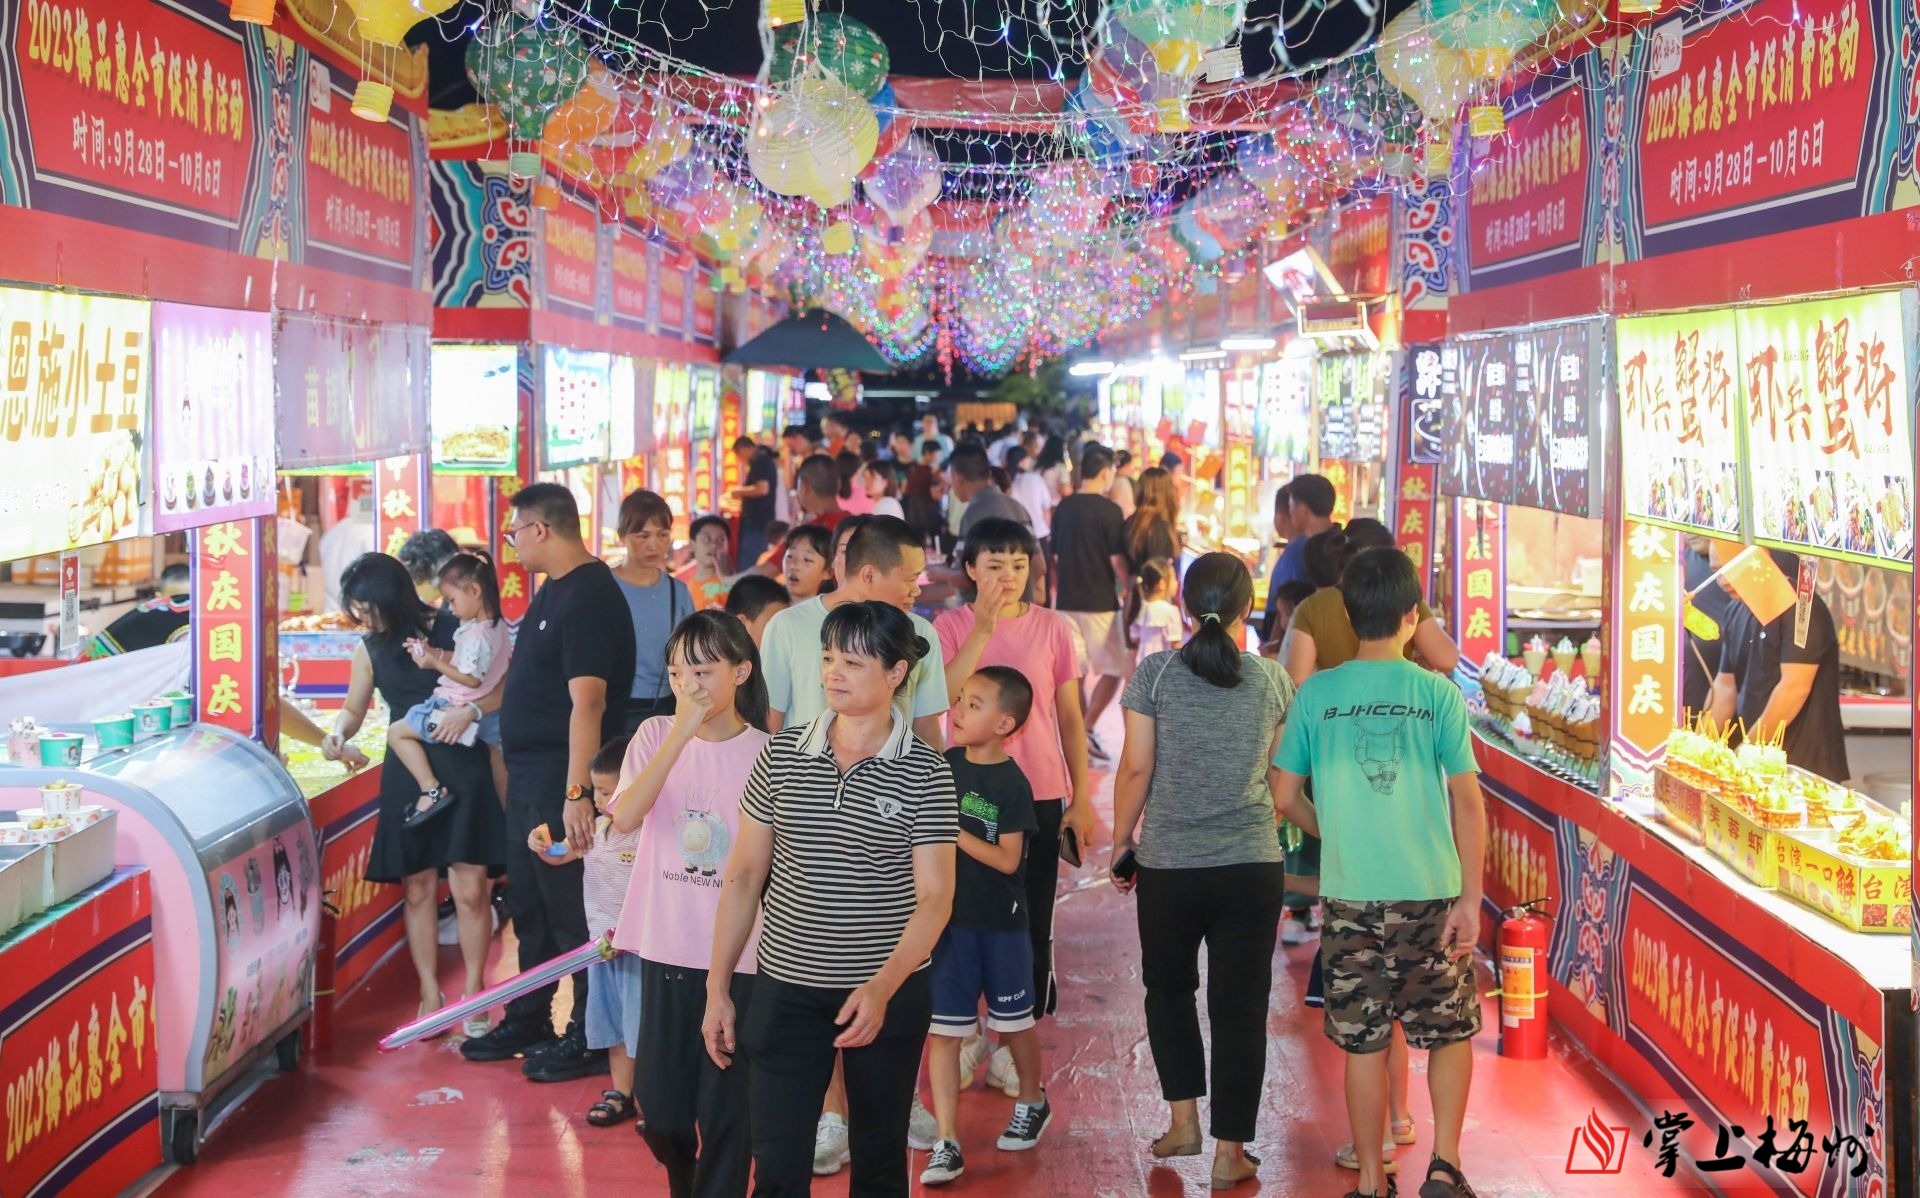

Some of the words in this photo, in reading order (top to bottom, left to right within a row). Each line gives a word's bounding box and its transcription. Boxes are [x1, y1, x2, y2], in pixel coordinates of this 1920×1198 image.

[1624, 328, 1732, 448] 虾兵蟹将
[1746, 316, 1897, 460] 虾兵蟹将
[203, 521, 248, 716] 秋庆国庆
[1627, 523, 1673, 715] 秋庆国庆
[882, 802, 893, 814] C
[1709, 803, 1764, 855] 芙蓉虾
[662, 870, 689, 883] Noble
[690, 875, 712, 887] NEW
[6, 974, 158, 1164] 2023梅品惠全市
